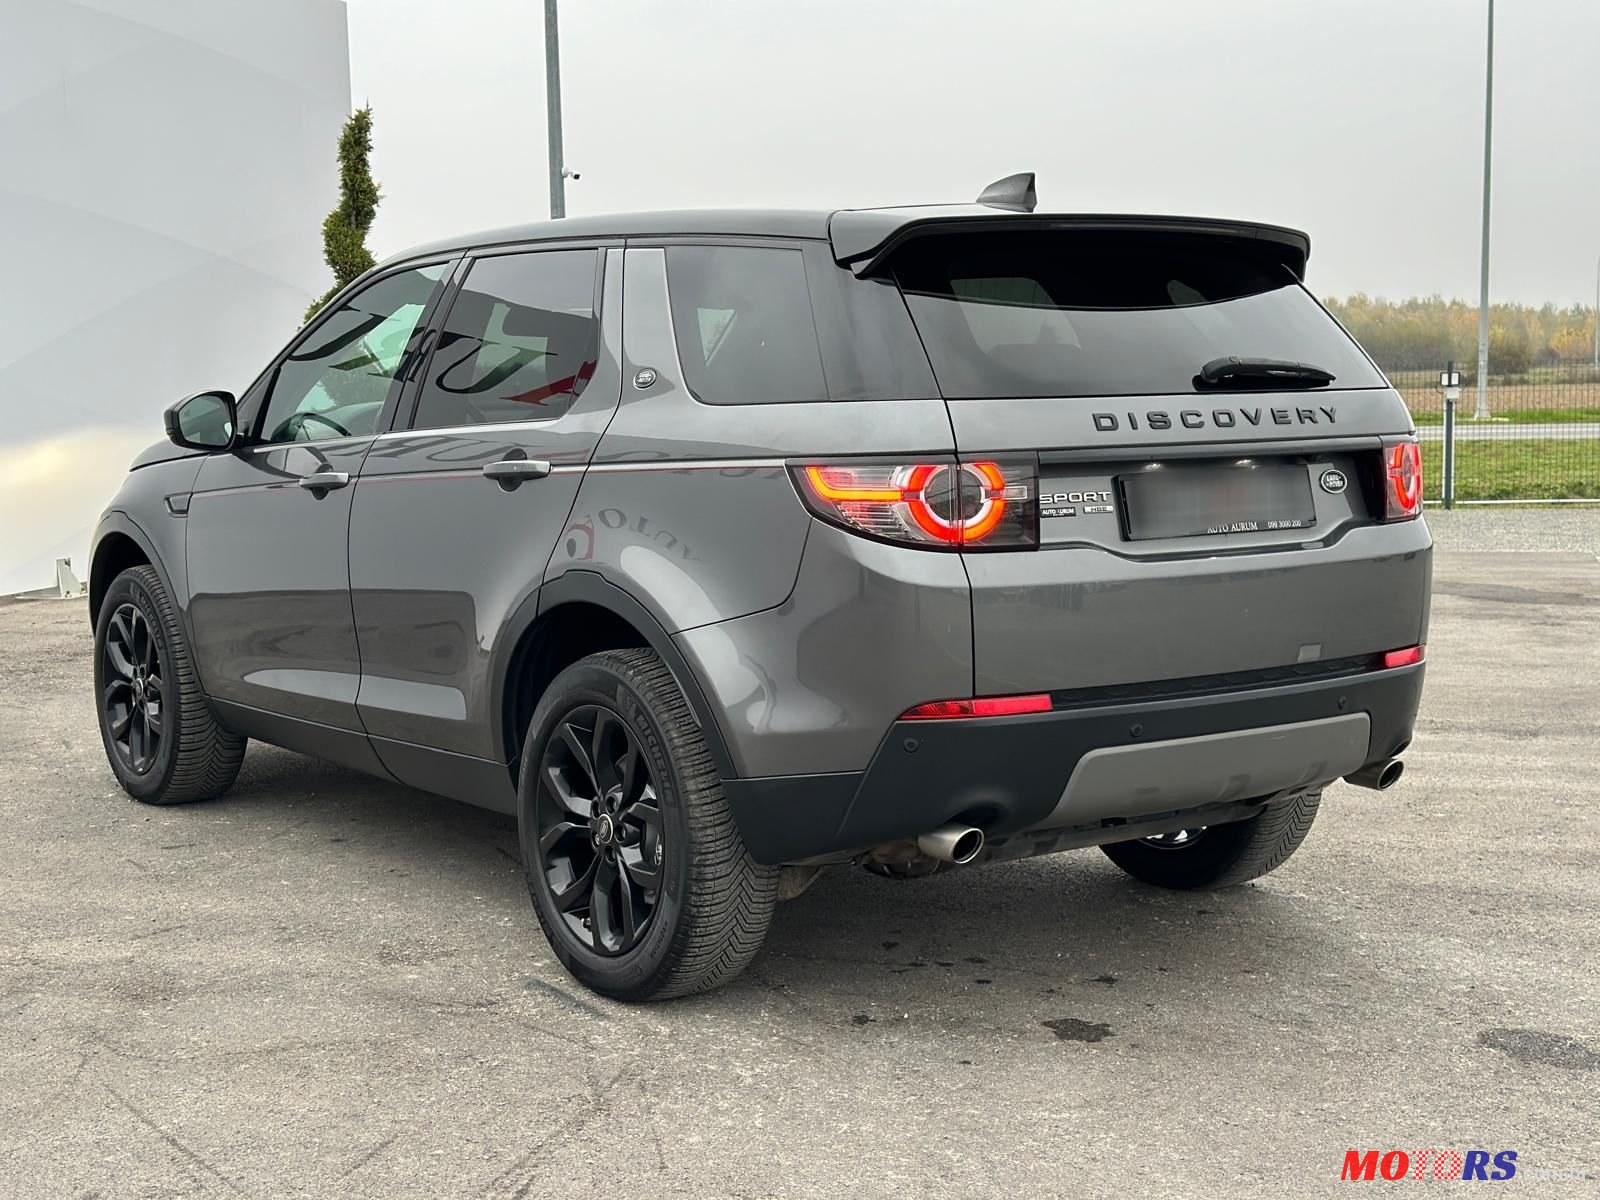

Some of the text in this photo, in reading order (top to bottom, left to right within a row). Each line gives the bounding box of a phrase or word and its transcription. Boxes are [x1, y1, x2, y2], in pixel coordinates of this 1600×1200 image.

[1092, 406, 1337, 432] DISCOVERY
[1040, 491, 1112, 504] SPORT
[1207, 519, 1302, 534] AUTO AURUM 099 3000 200
